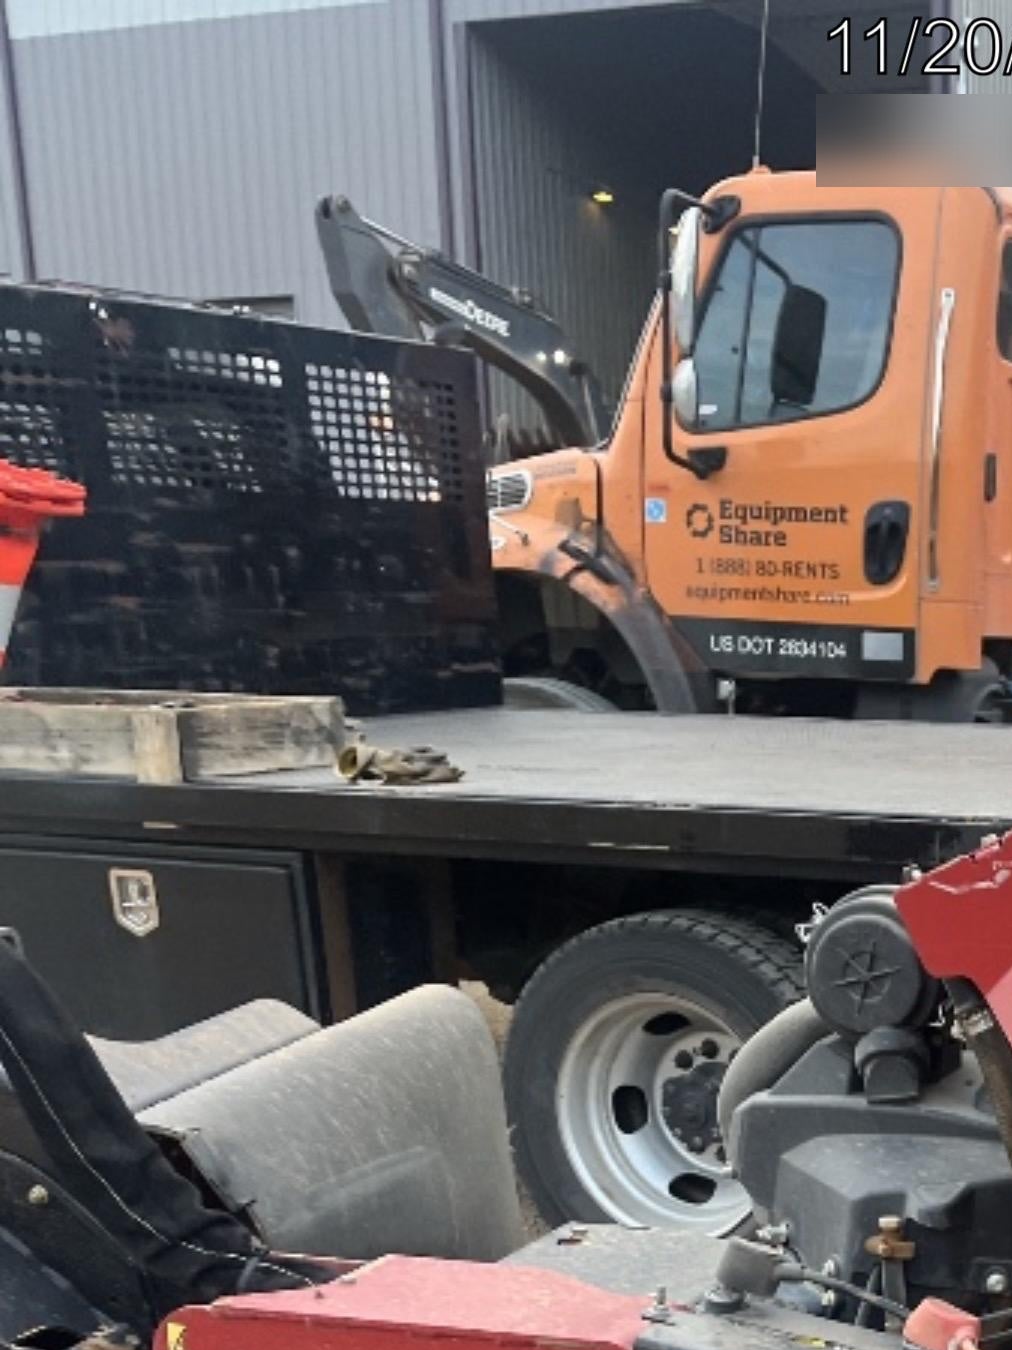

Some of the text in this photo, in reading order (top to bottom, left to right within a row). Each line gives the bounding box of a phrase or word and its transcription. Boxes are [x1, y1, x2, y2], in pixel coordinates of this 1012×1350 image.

[718, 499, 848, 526] Equipment
[718, 524, 787, 547] Share
[686, 583, 850, 606] equipmentshare.com
[710, 634, 847, 659] US DOT 2834104
